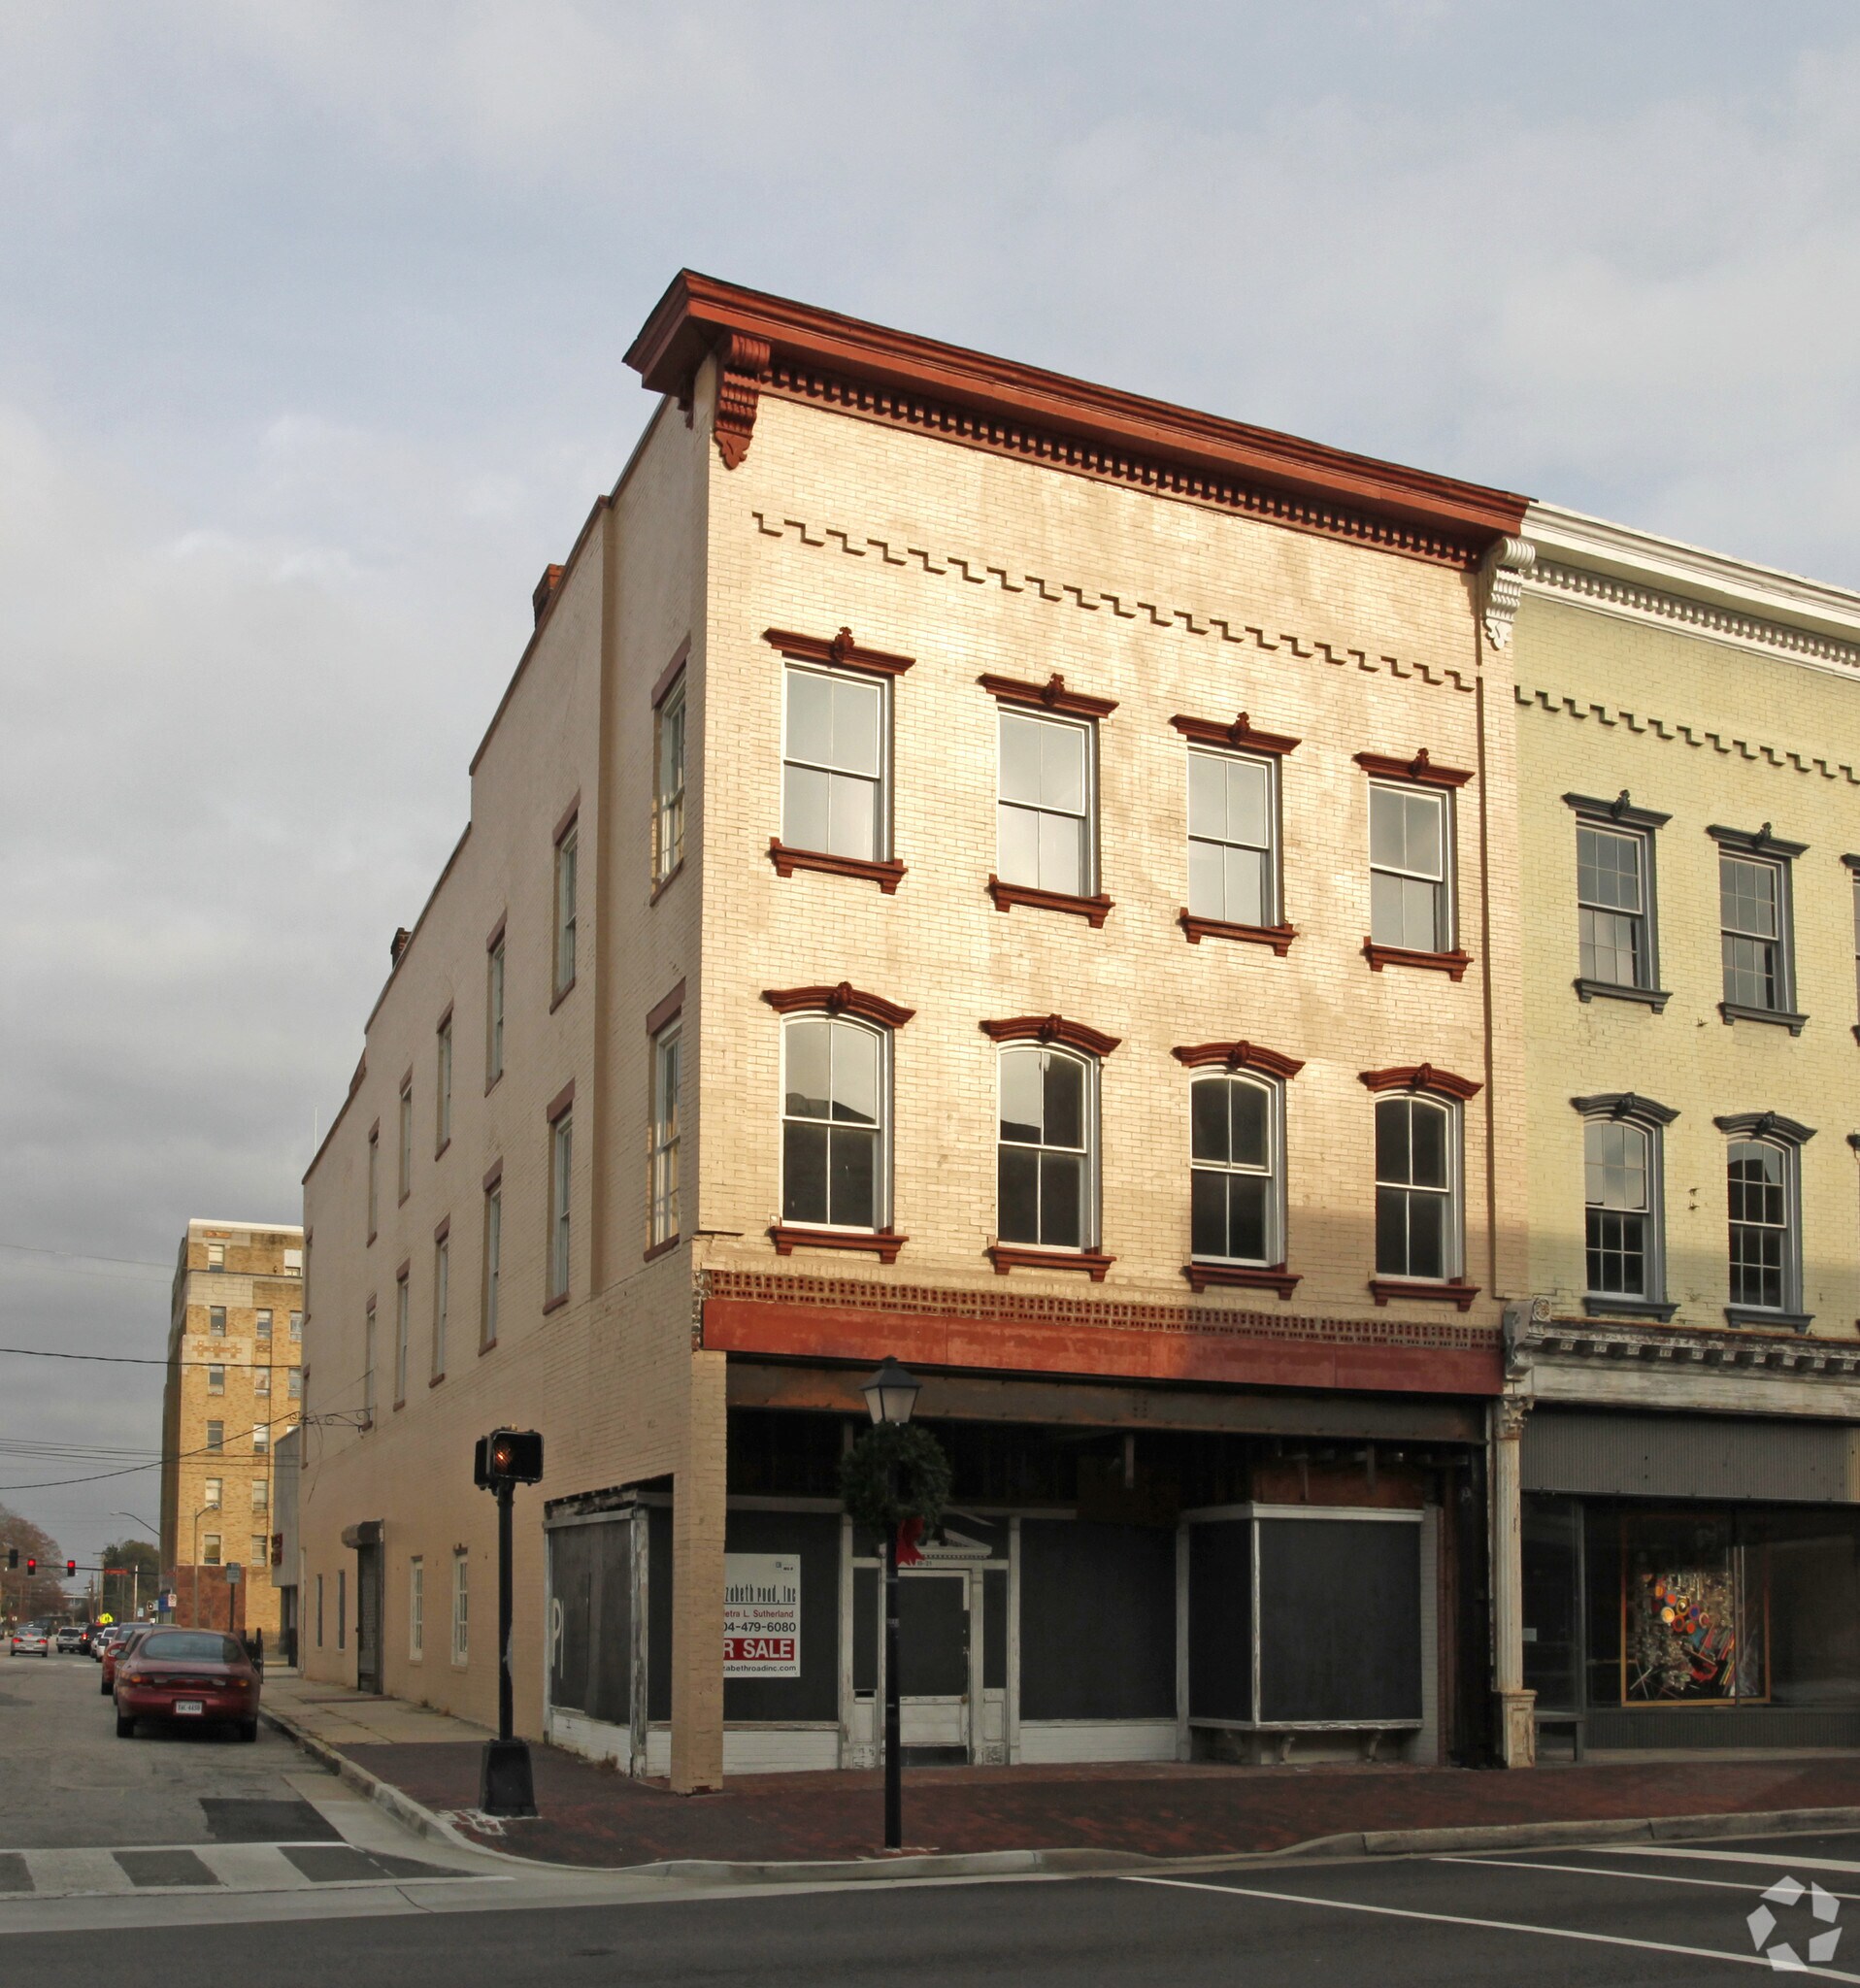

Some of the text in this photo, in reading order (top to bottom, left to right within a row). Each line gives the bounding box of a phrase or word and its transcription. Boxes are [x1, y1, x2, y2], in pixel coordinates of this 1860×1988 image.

[723, 1609, 740, 1618] etra
[752, 1609, 794, 1618] Sutherland
[743, 1640, 791, 1658] SALE
